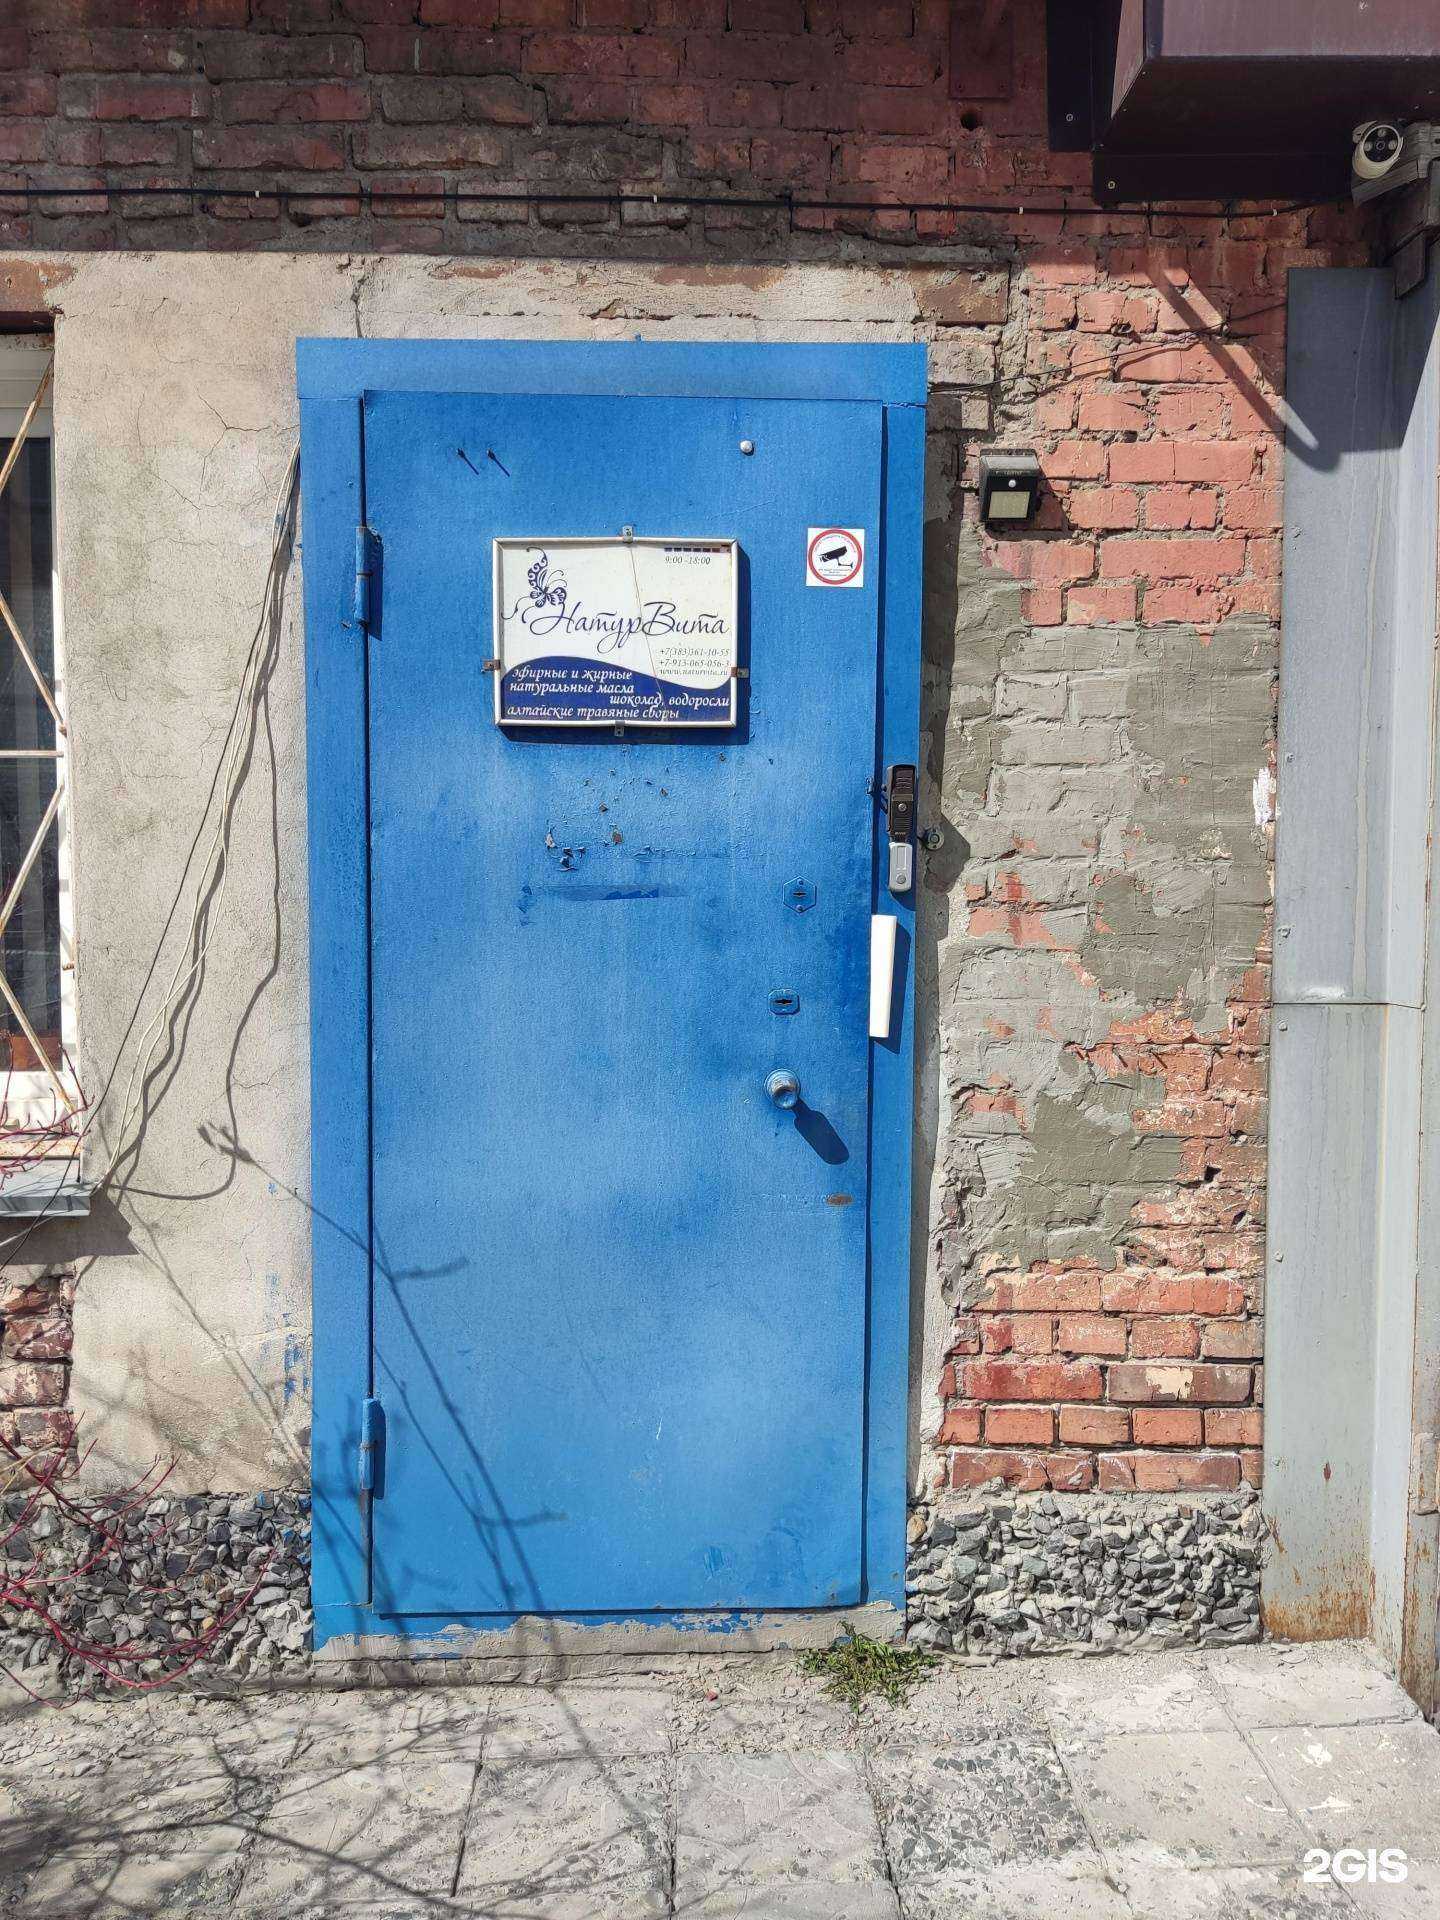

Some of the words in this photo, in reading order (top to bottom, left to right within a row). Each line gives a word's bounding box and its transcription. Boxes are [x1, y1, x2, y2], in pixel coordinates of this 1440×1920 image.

[528, 601, 730, 654] НатурВита
[512, 665, 568, 681] эфирные
[571, 669, 579, 678] и
[582, 668, 633, 683] жирные
[510, 681, 594, 696] натуральные
[596, 683, 634, 694] масла
[609, 692, 664, 707] шоколад,
[669, 693, 730, 711] водоросли
[507, 704, 574, 719] алтайские
[577, 707, 640, 720] травяные
[642, 704, 680, 721] сборы
